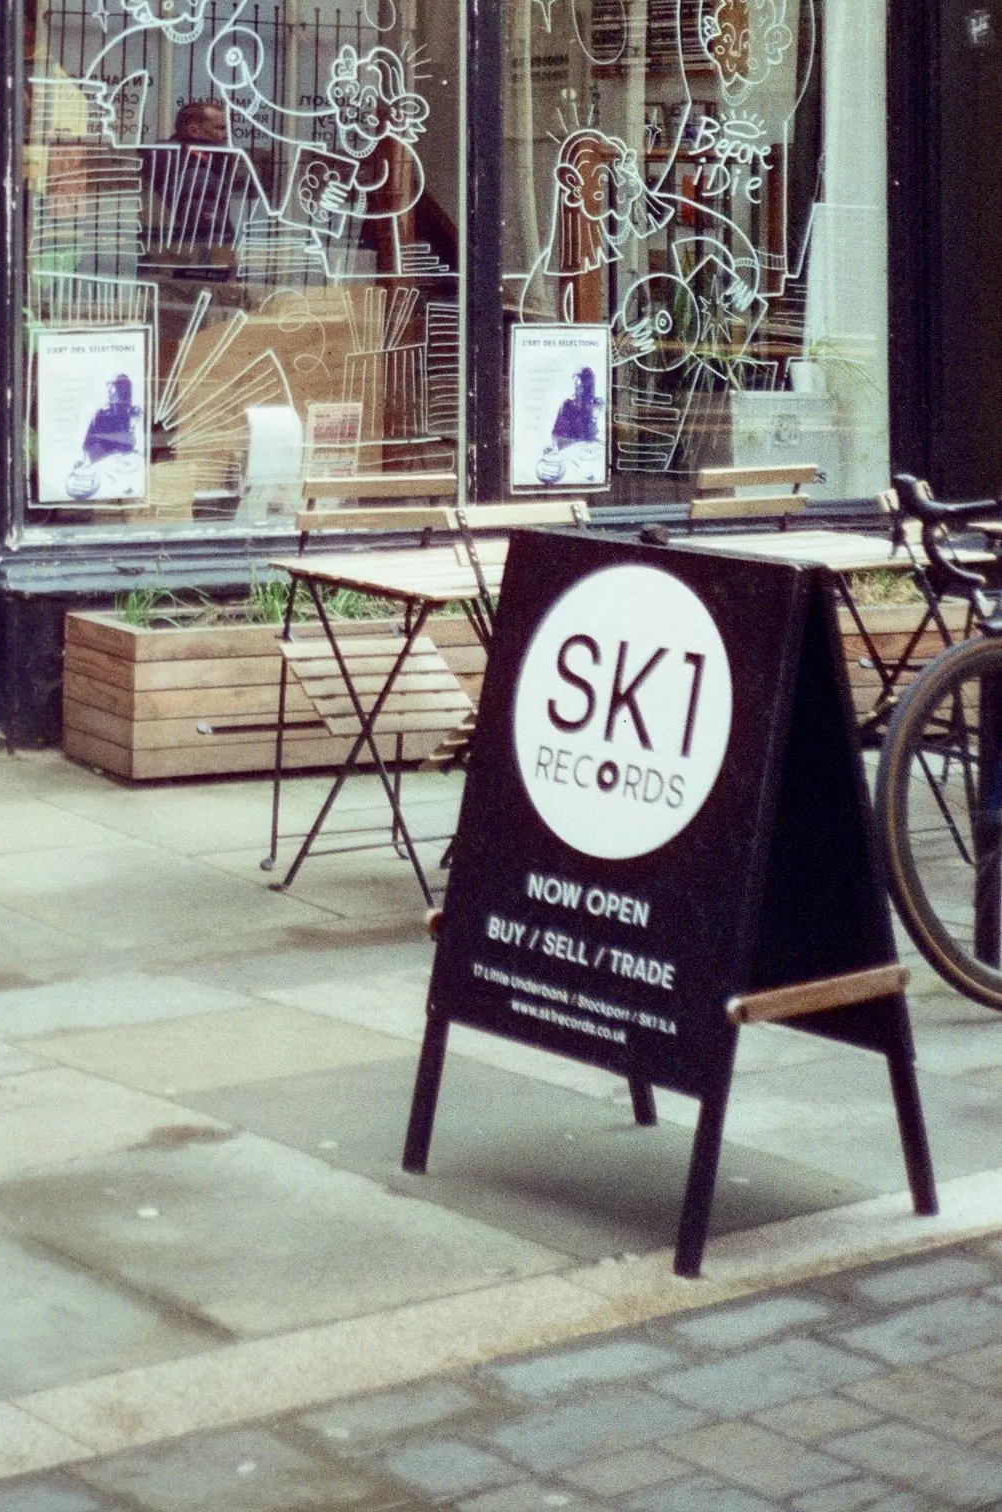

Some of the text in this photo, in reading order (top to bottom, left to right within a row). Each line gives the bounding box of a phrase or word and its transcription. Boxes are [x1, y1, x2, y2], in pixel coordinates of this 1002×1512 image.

[546, 633, 706, 759] SK1
[534, 745, 685, 810] RECORDS
[527, 872, 650, 927] NOW OPEN
[487, 914, 526, 946] BUY
[542, 930, 588, 966] SELL
[610, 948, 676, 990] TRADE
